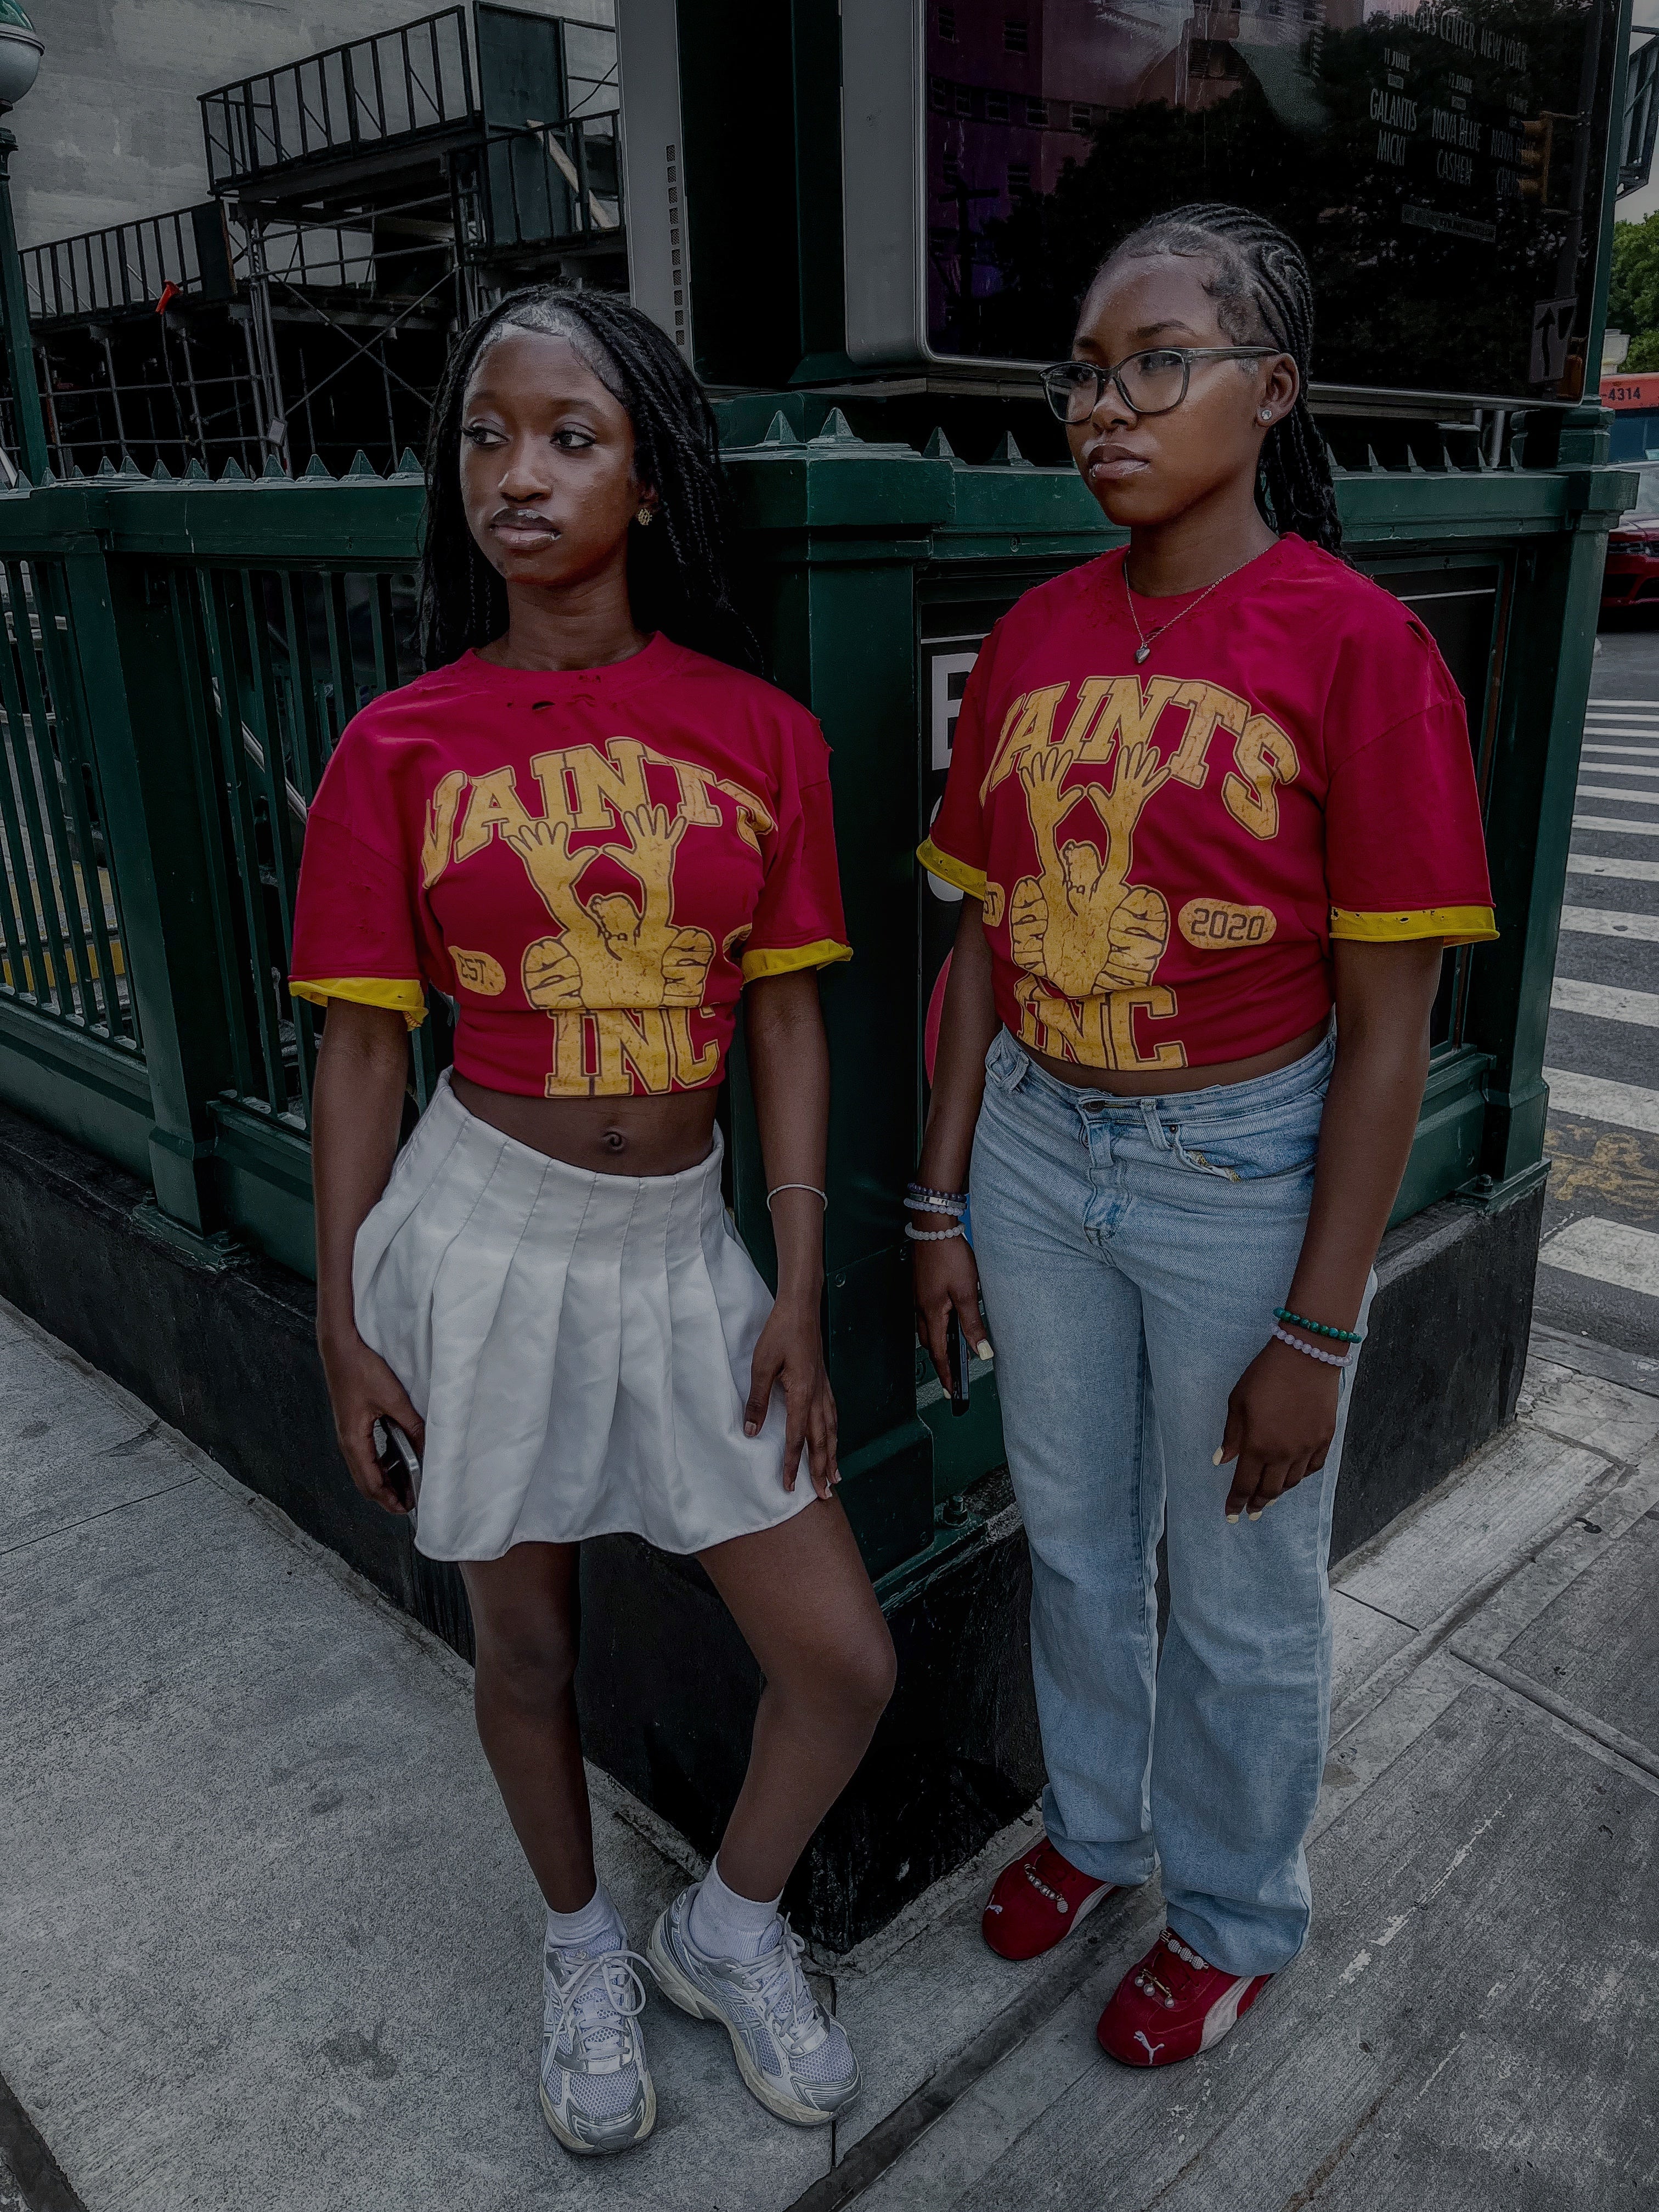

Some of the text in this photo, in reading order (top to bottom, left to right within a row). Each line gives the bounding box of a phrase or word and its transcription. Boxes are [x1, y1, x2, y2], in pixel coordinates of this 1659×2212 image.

[1391, 51, 1410, 72] JUNE
[1481, 28, 1502, 61] NEW
[1370, 88, 1418, 132] GALANTIS
[1431, 108, 1457, 145] NOVA
[1190, 907, 1265, 941] 2020
[1014, 972, 1188, 1071] INC
[544, 1004, 720, 1098] INC
